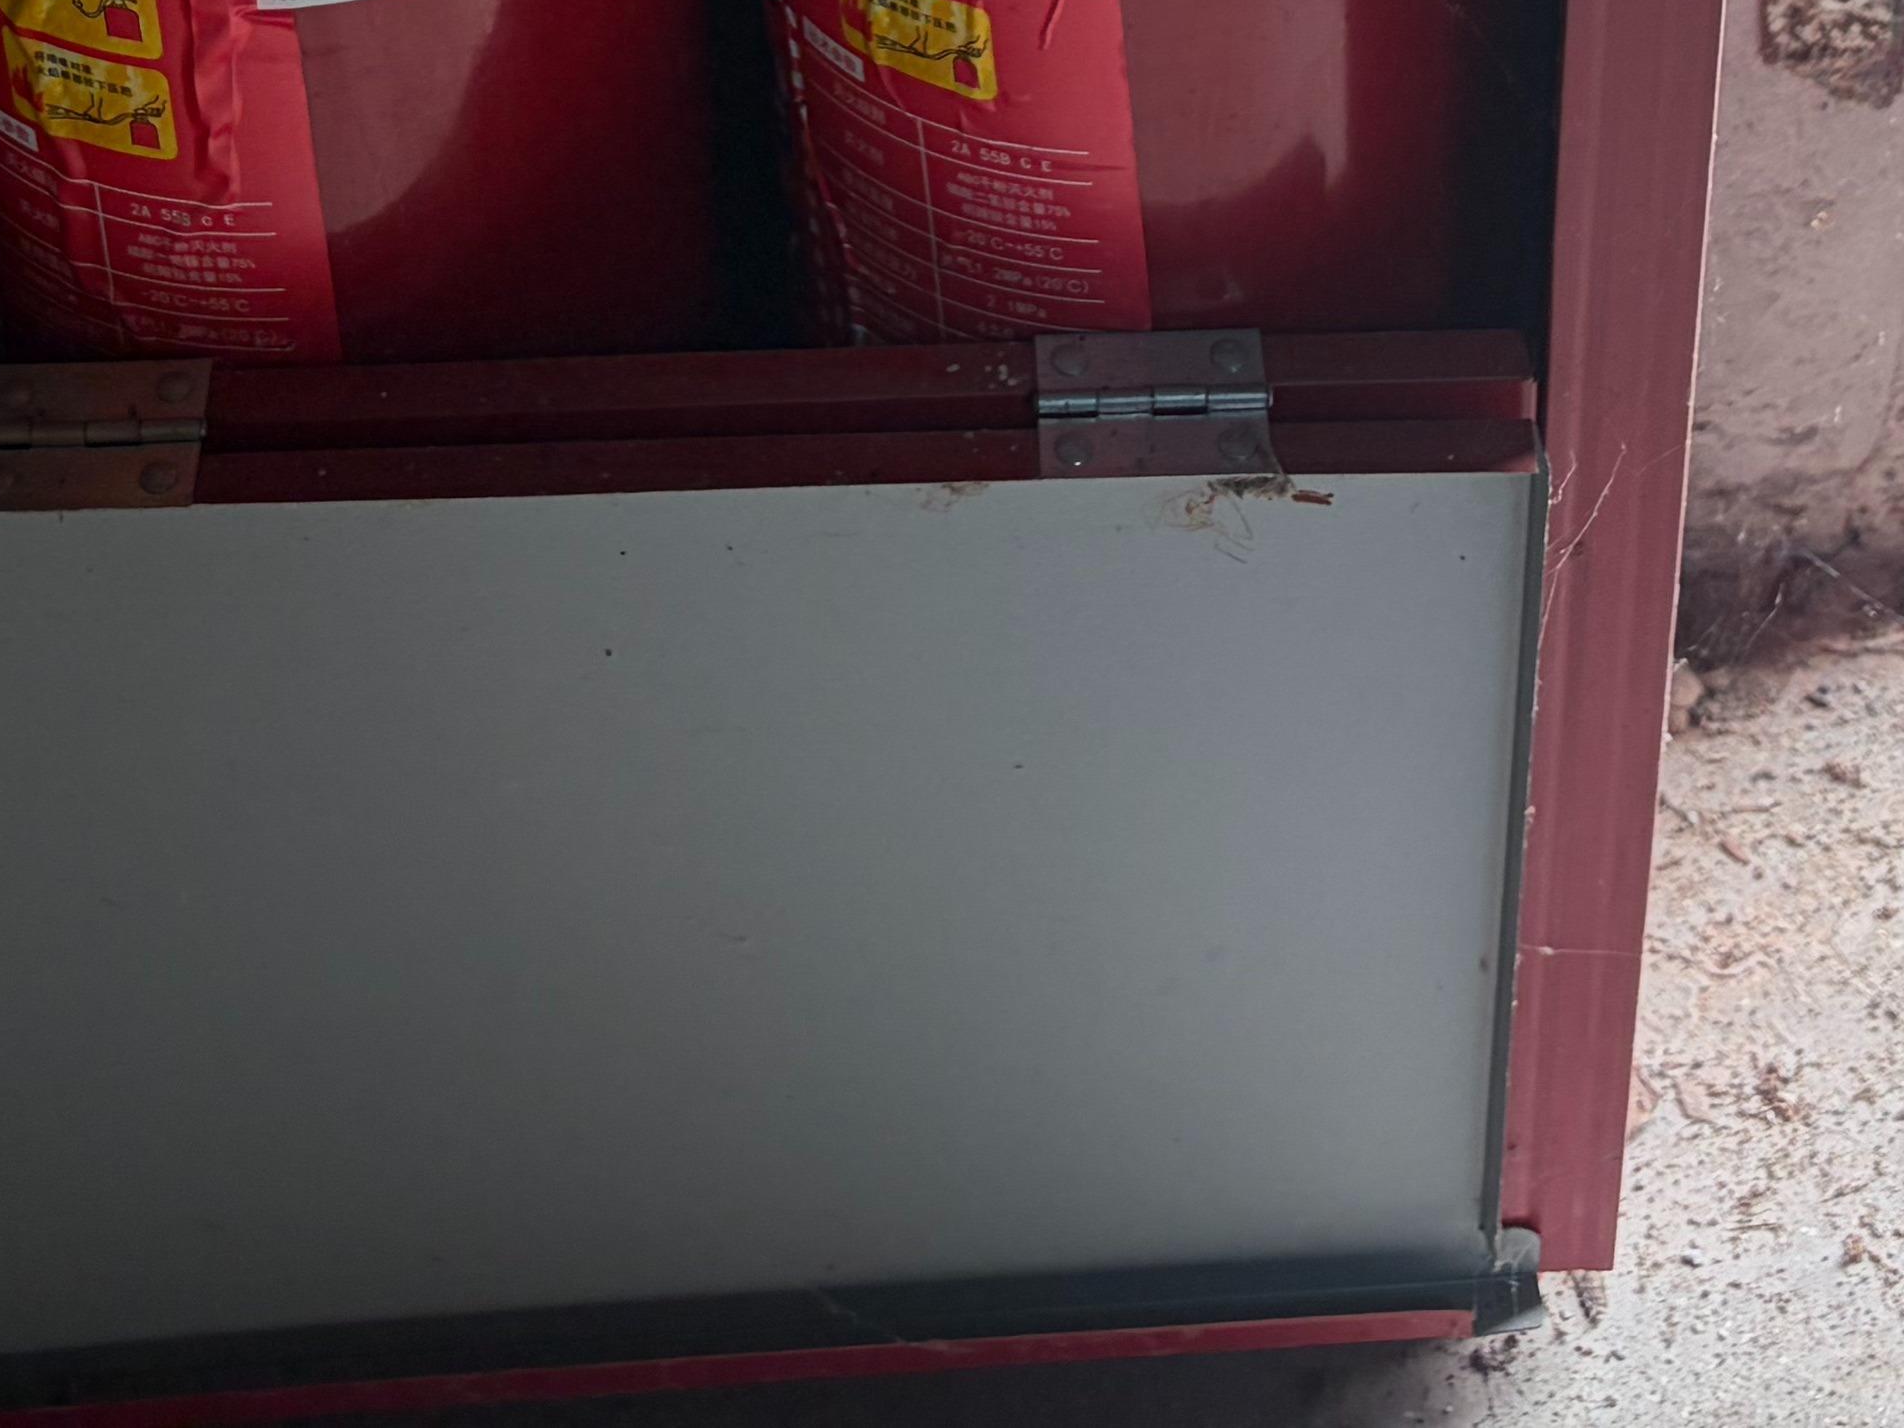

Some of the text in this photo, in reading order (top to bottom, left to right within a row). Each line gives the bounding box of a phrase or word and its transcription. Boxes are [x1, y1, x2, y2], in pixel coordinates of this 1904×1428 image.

[951, 140, 1053, 172] 2A 55B C E
[130, 203, 152, 220] 2A
[223, 213, 237, 227] E
